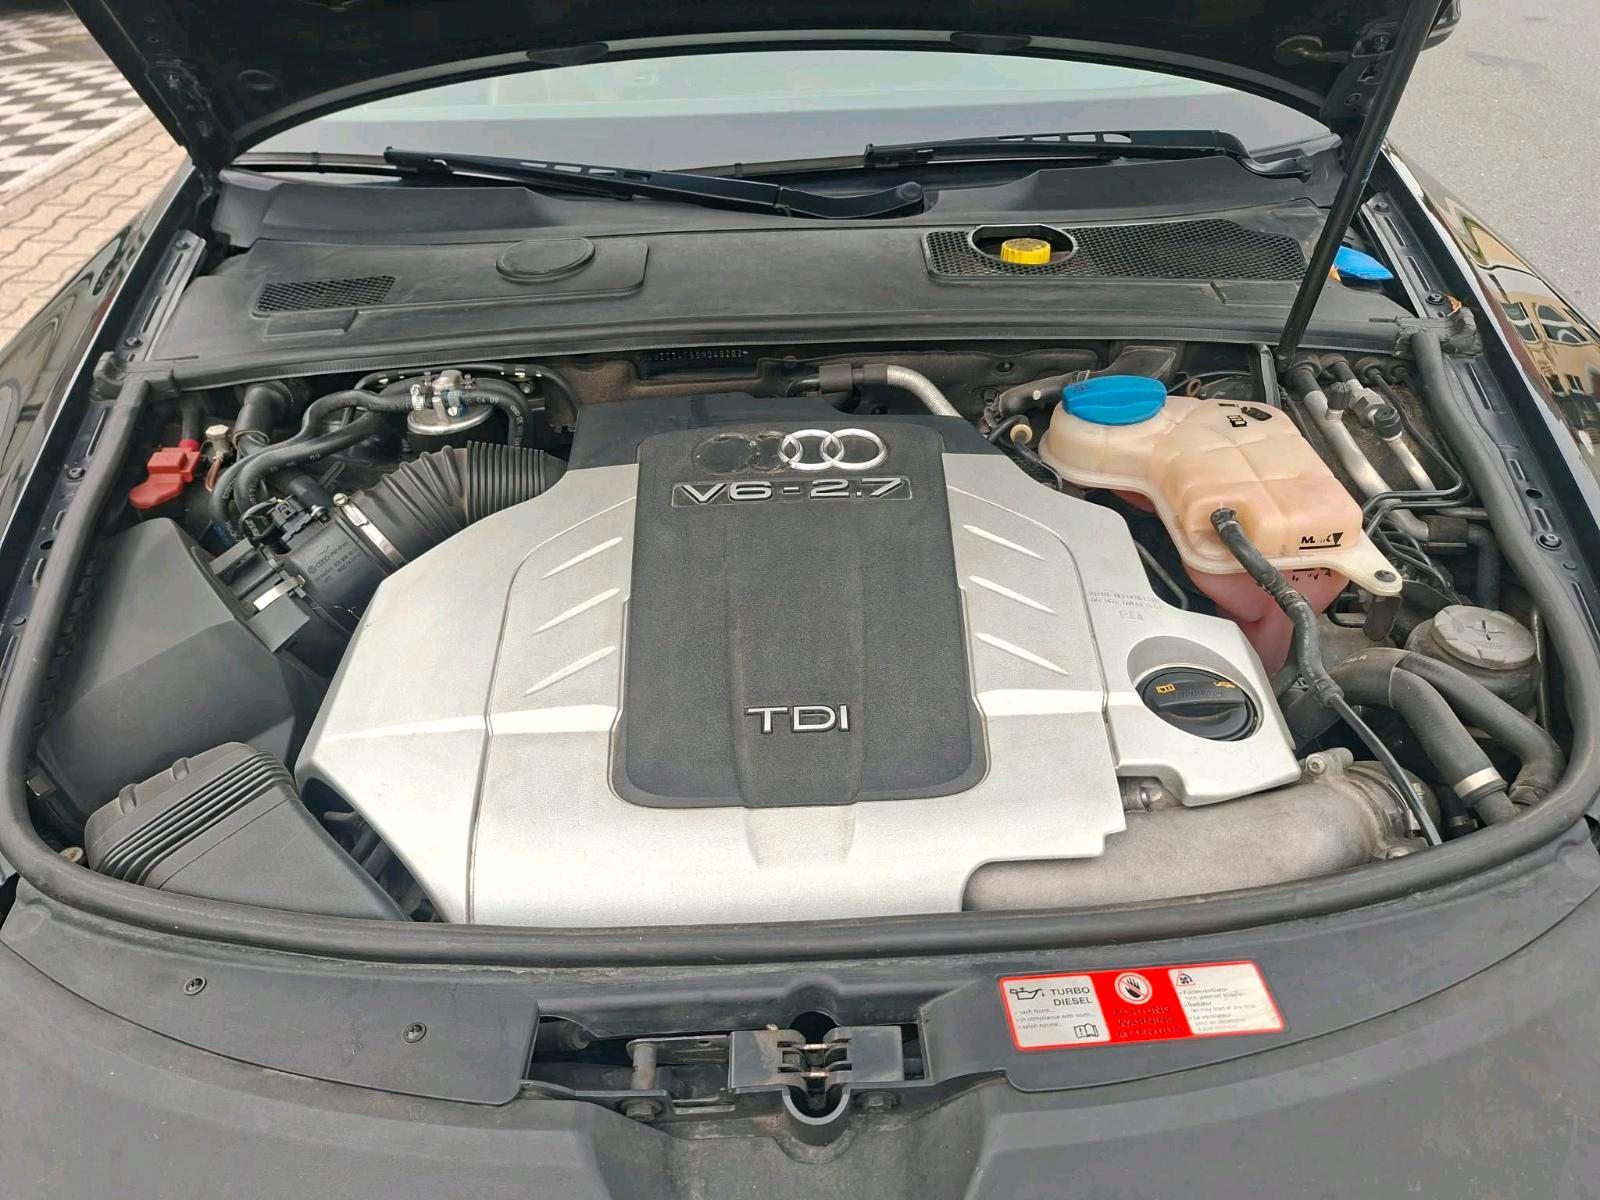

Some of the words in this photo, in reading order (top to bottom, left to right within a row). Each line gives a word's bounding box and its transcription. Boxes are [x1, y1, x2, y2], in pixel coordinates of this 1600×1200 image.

[747, 704, 850, 734] TDI
[1051, 987, 1090, 996] TURBO
[1053, 996, 1093, 1006] DIESEL
[1117, 1016, 1176, 1026] WARNING
